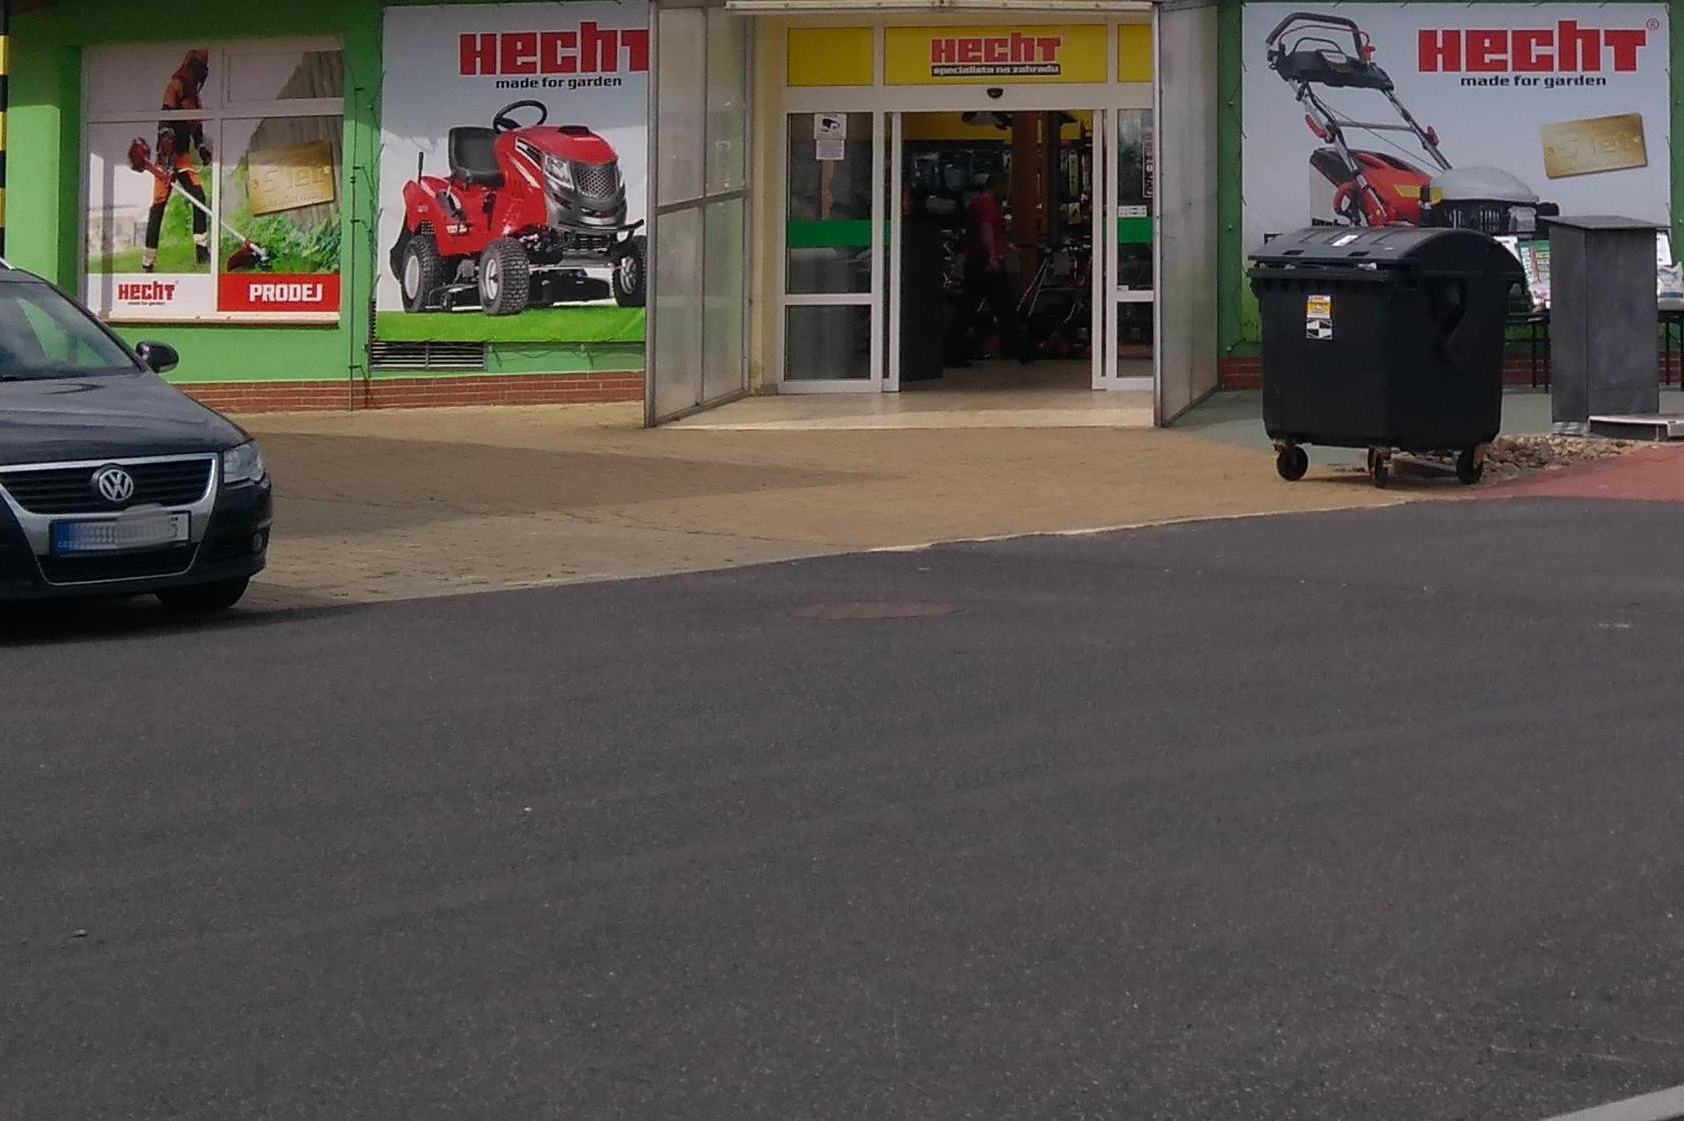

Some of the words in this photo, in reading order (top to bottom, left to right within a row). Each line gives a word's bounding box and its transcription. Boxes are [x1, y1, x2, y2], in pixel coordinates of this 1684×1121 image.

[495, 77, 539, 89] made
[541, 76, 564, 88] for
[567, 76, 622, 91] garden
[1460, 75, 1510, 87] made
[1514, 75, 1540, 87] for
[1543, 74, 1607, 89] garden
[249, 283, 324, 302] PRODEJ
